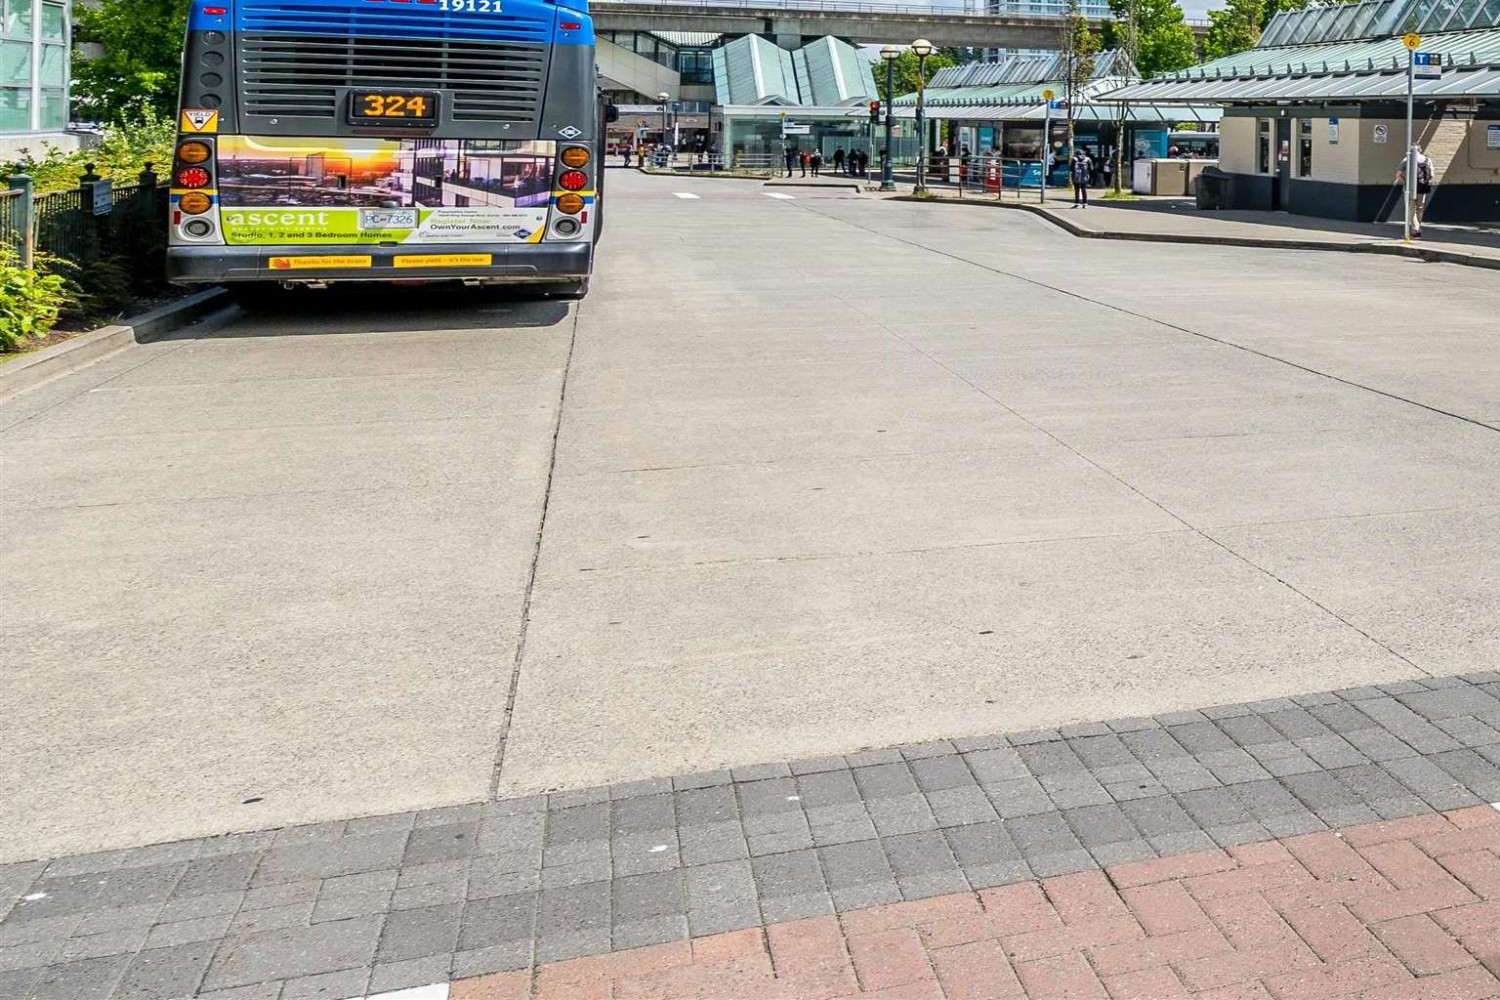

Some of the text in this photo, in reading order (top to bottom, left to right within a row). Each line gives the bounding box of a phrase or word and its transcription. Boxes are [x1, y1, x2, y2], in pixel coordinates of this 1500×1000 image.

[1417, 54, 1426, 64] T
[364, 95, 426, 117] 324
[229, 212, 329, 226] ascent
